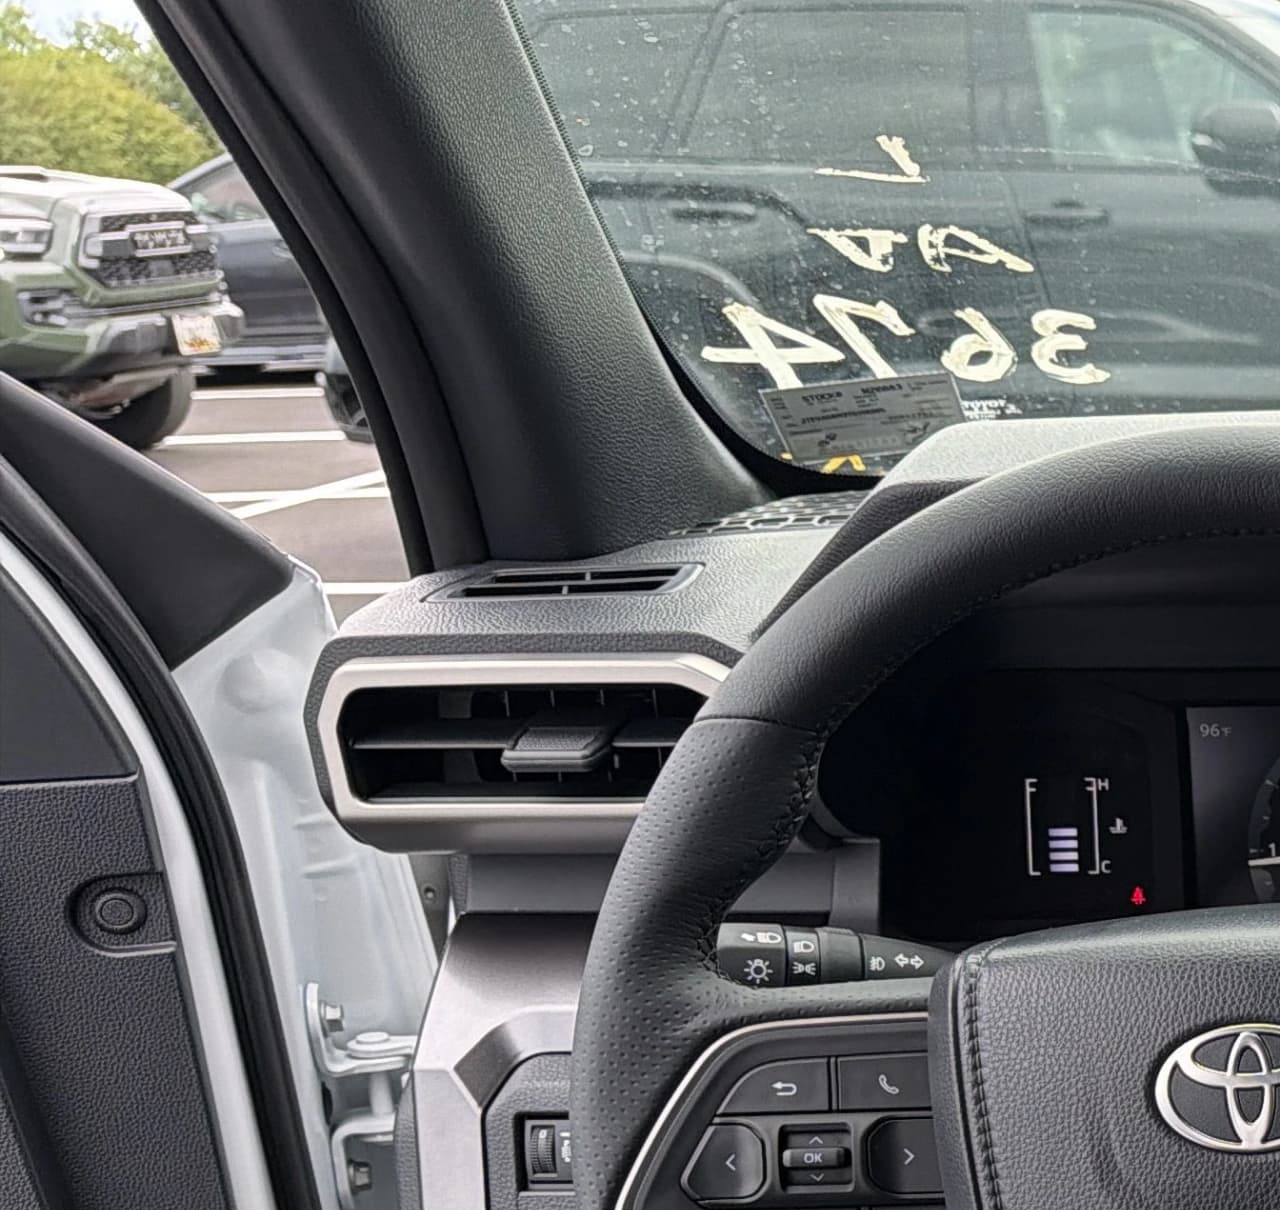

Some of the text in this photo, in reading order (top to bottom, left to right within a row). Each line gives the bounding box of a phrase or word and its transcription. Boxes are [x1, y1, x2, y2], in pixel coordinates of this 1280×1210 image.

[1097, 778, 1109, 791] H
[1268, 843, 1277, 857] 1
[803, 1152, 822, 1164] OK
